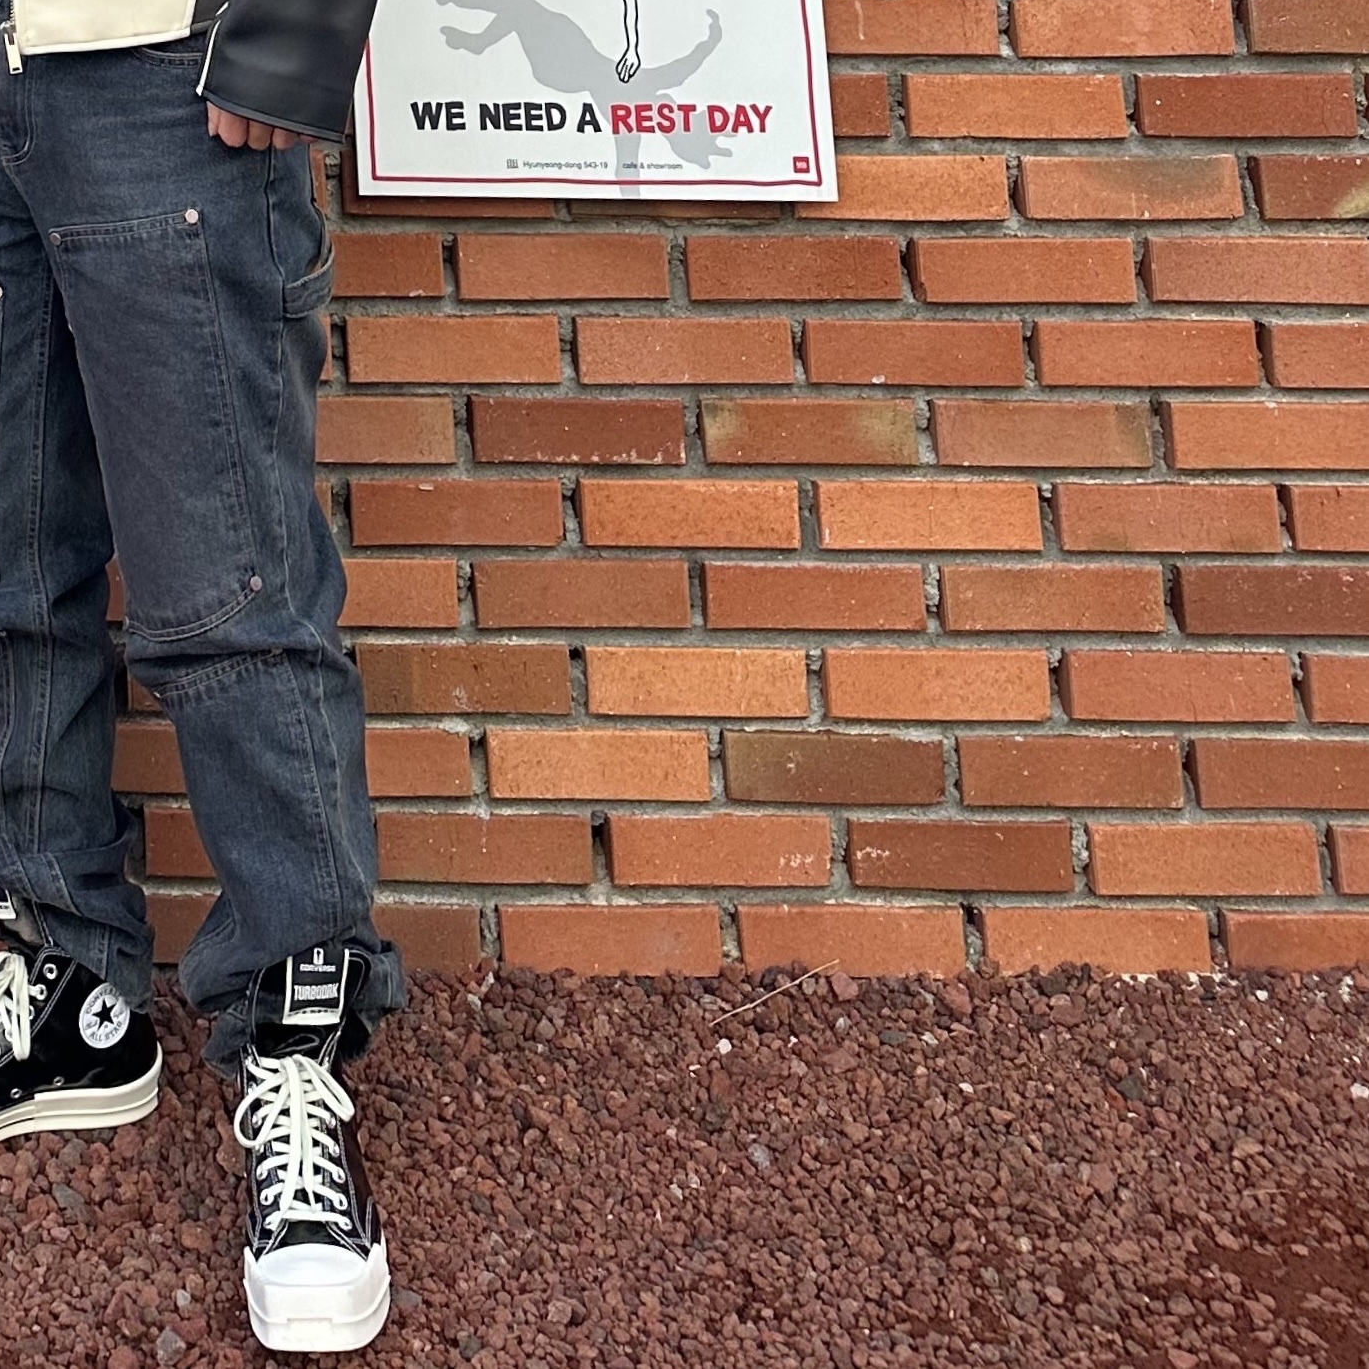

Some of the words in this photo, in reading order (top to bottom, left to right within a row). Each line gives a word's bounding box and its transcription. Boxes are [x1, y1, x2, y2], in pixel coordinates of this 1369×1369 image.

[411, 102, 466, 131] WE
[480, 102, 566, 131] NEED
[577, 103, 602, 133] A
[611, 104, 696, 134] REST
[707, 104, 772, 133] DAY
